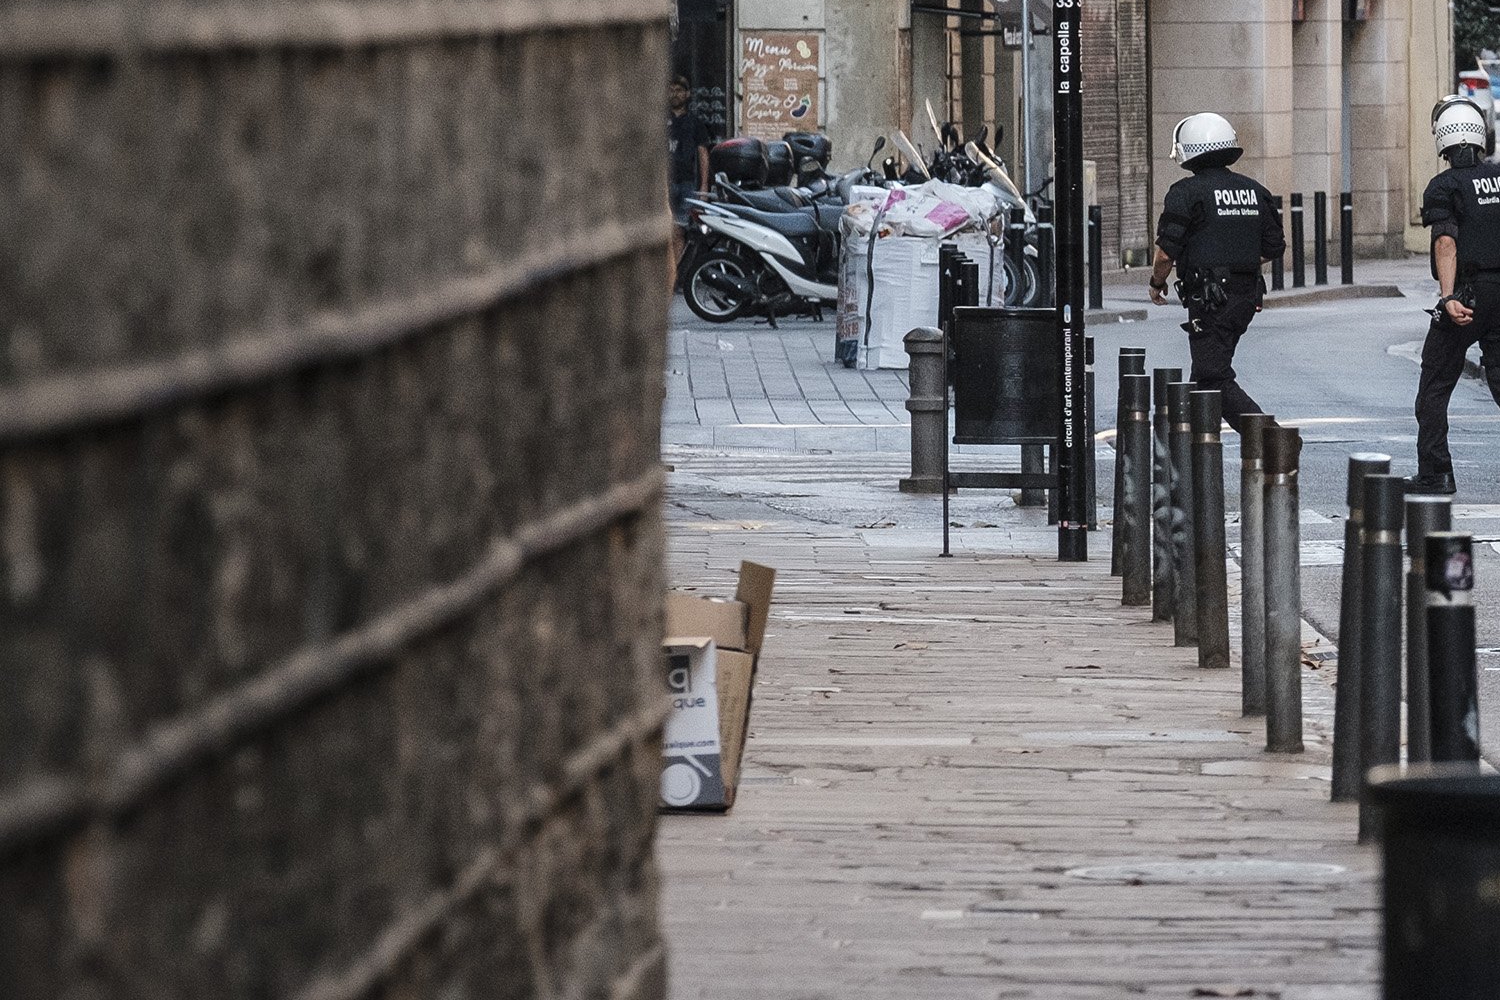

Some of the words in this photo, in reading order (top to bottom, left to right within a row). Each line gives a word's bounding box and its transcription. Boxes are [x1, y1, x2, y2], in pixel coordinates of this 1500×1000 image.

[745, 37, 792, 58] Menu
[1058, 21, 1073, 73] capella
[1058, 80, 1070, 94] la
[1213, 189, 1258, 206] POLICIA
[1240, 207, 1259, 216] Urbana
[1063, 328, 1073, 393] contemporani
[1064, 394, 1072, 416] d'art
[1064, 418, 1073, 448] circuit
[672, 696, 706, 710] que
